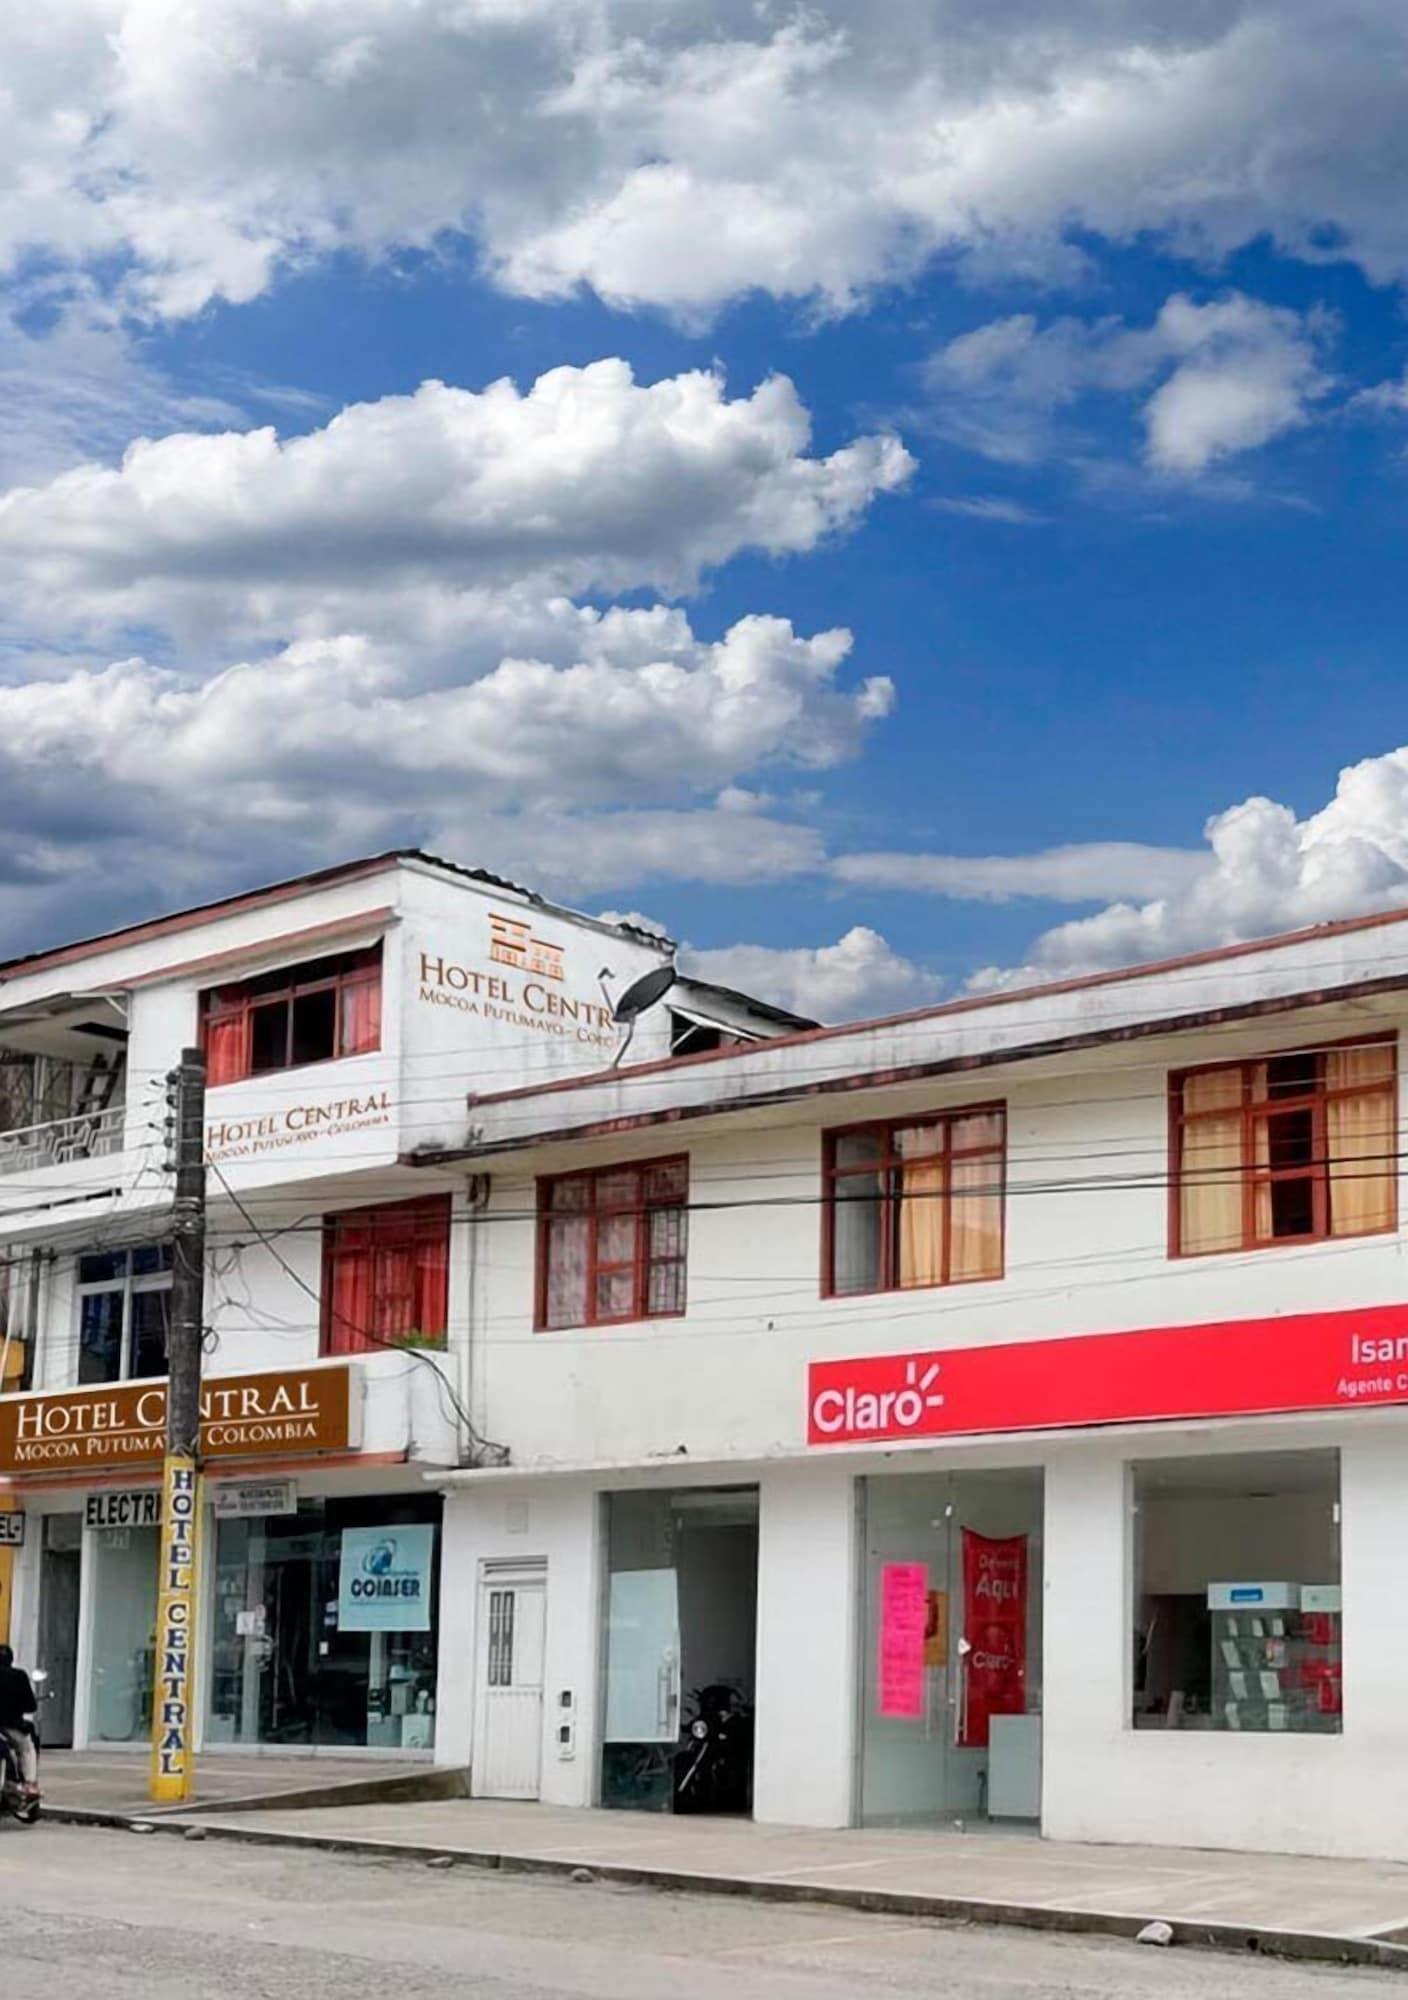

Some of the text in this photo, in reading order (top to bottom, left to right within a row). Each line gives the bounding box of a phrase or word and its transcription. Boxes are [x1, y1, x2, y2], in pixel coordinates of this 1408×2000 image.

[419, 987, 478, 1014] MOCOA
[420, 953, 614, 1030] HOTEL CENTR
[207, 1091, 391, 1148] HOTEL CENTRAL
[17, 1381, 320, 1438] HOTEL CNTRAL
[813, 1386, 922, 1433] Claro
[1336, 1377, 1393, 1398] Agente
[14, 1441, 80, 1462] MOCOA
[207, 1421, 317, 1447] COLOMBIA
[169, 1469, 193, 1589] HOTEL
[161, 1604, 187, 1774] CENTRAL
